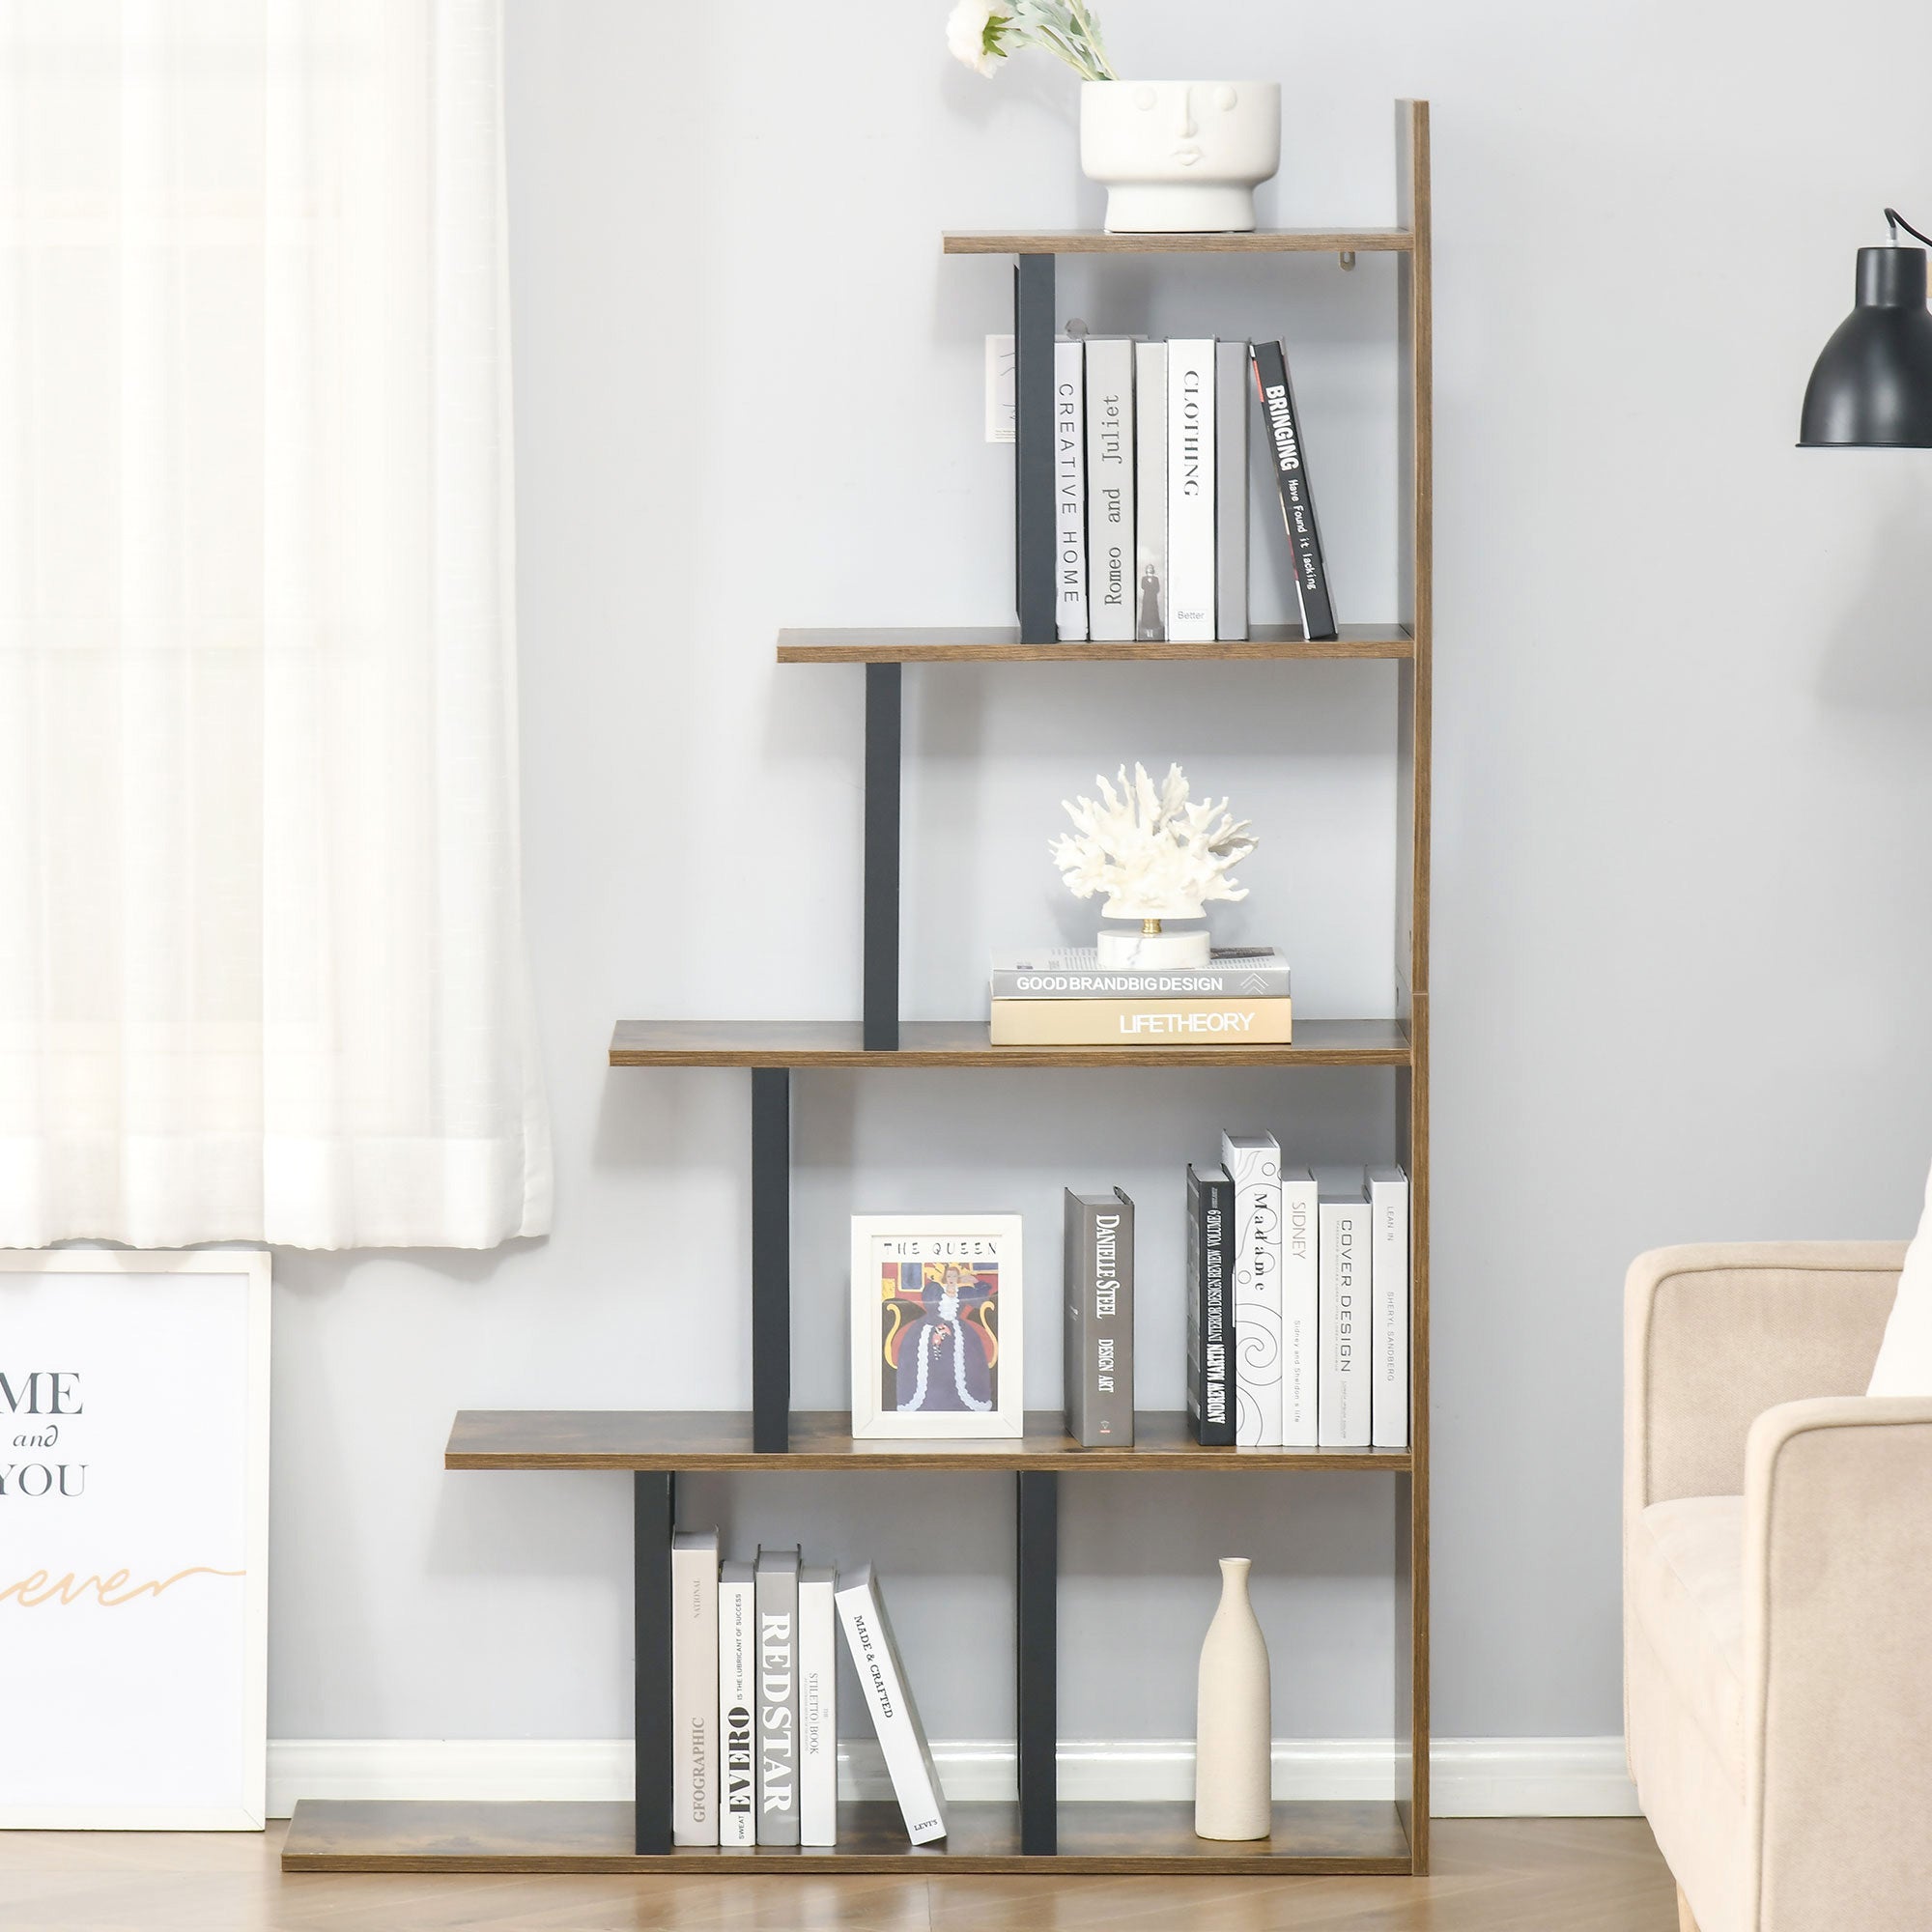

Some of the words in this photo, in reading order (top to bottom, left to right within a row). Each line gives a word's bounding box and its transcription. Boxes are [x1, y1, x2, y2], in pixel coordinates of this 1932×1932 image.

[1101, 394, 1122, 464] Juliet
[1183, 371, 1199, 497] CLOTHING
[1265, 385, 1299, 470] BRINGING
[1059, 384, 1077, 514] CREATIVE
[1102, 488, 1121, 523] and
[1289, 479, 1299, 502] Have
[1293, 504, 1308, 532] Found
[1300, 537, 1309, 548] it
[1063, 531, 1079, 602] HOME
[1105, 547, 1122, 606] Romeo
[1303, 554, 1316, 590] lacking
[884, 1242, 920, 1255] THE
[933, 1242, 997, 1255] QUEEN
[1254, 1193, 1266, 1290] Madame
[1292, 1202, 1306, 1260] SIDNEY
[1387, 1233, 1394, 1241] IN
[1208, 1250, 1222, 1277] REVIEW
[1341, 1219, 1352, 1287] COVER
[1208, 1277, 1222, 1306] DESIGN
[1208, 1307, 1223, 1342] INTERIOR
[1341, 1295, 1352, 1372] DESIGN
[1098, 1339, 1114, 1371] DESIGN
[1208, 1344, 1224, 1381] MARTIN
[1098, 1375, 1114, 1392] ART
[1208, 1382, 1225, 1424] ANDREW
[13, 1425, 59, 1447] and
[736, 1628, 742, 1636] OF
[854, 1615, 872, 1651] MADE
[870, 1663, 893, 1719] CRAFTED
[810, 1673, 818, 1721] STILETTO
[810, 1726, 819, 1754] BOOK
[727, 1707, 751, 1814] EVERO
